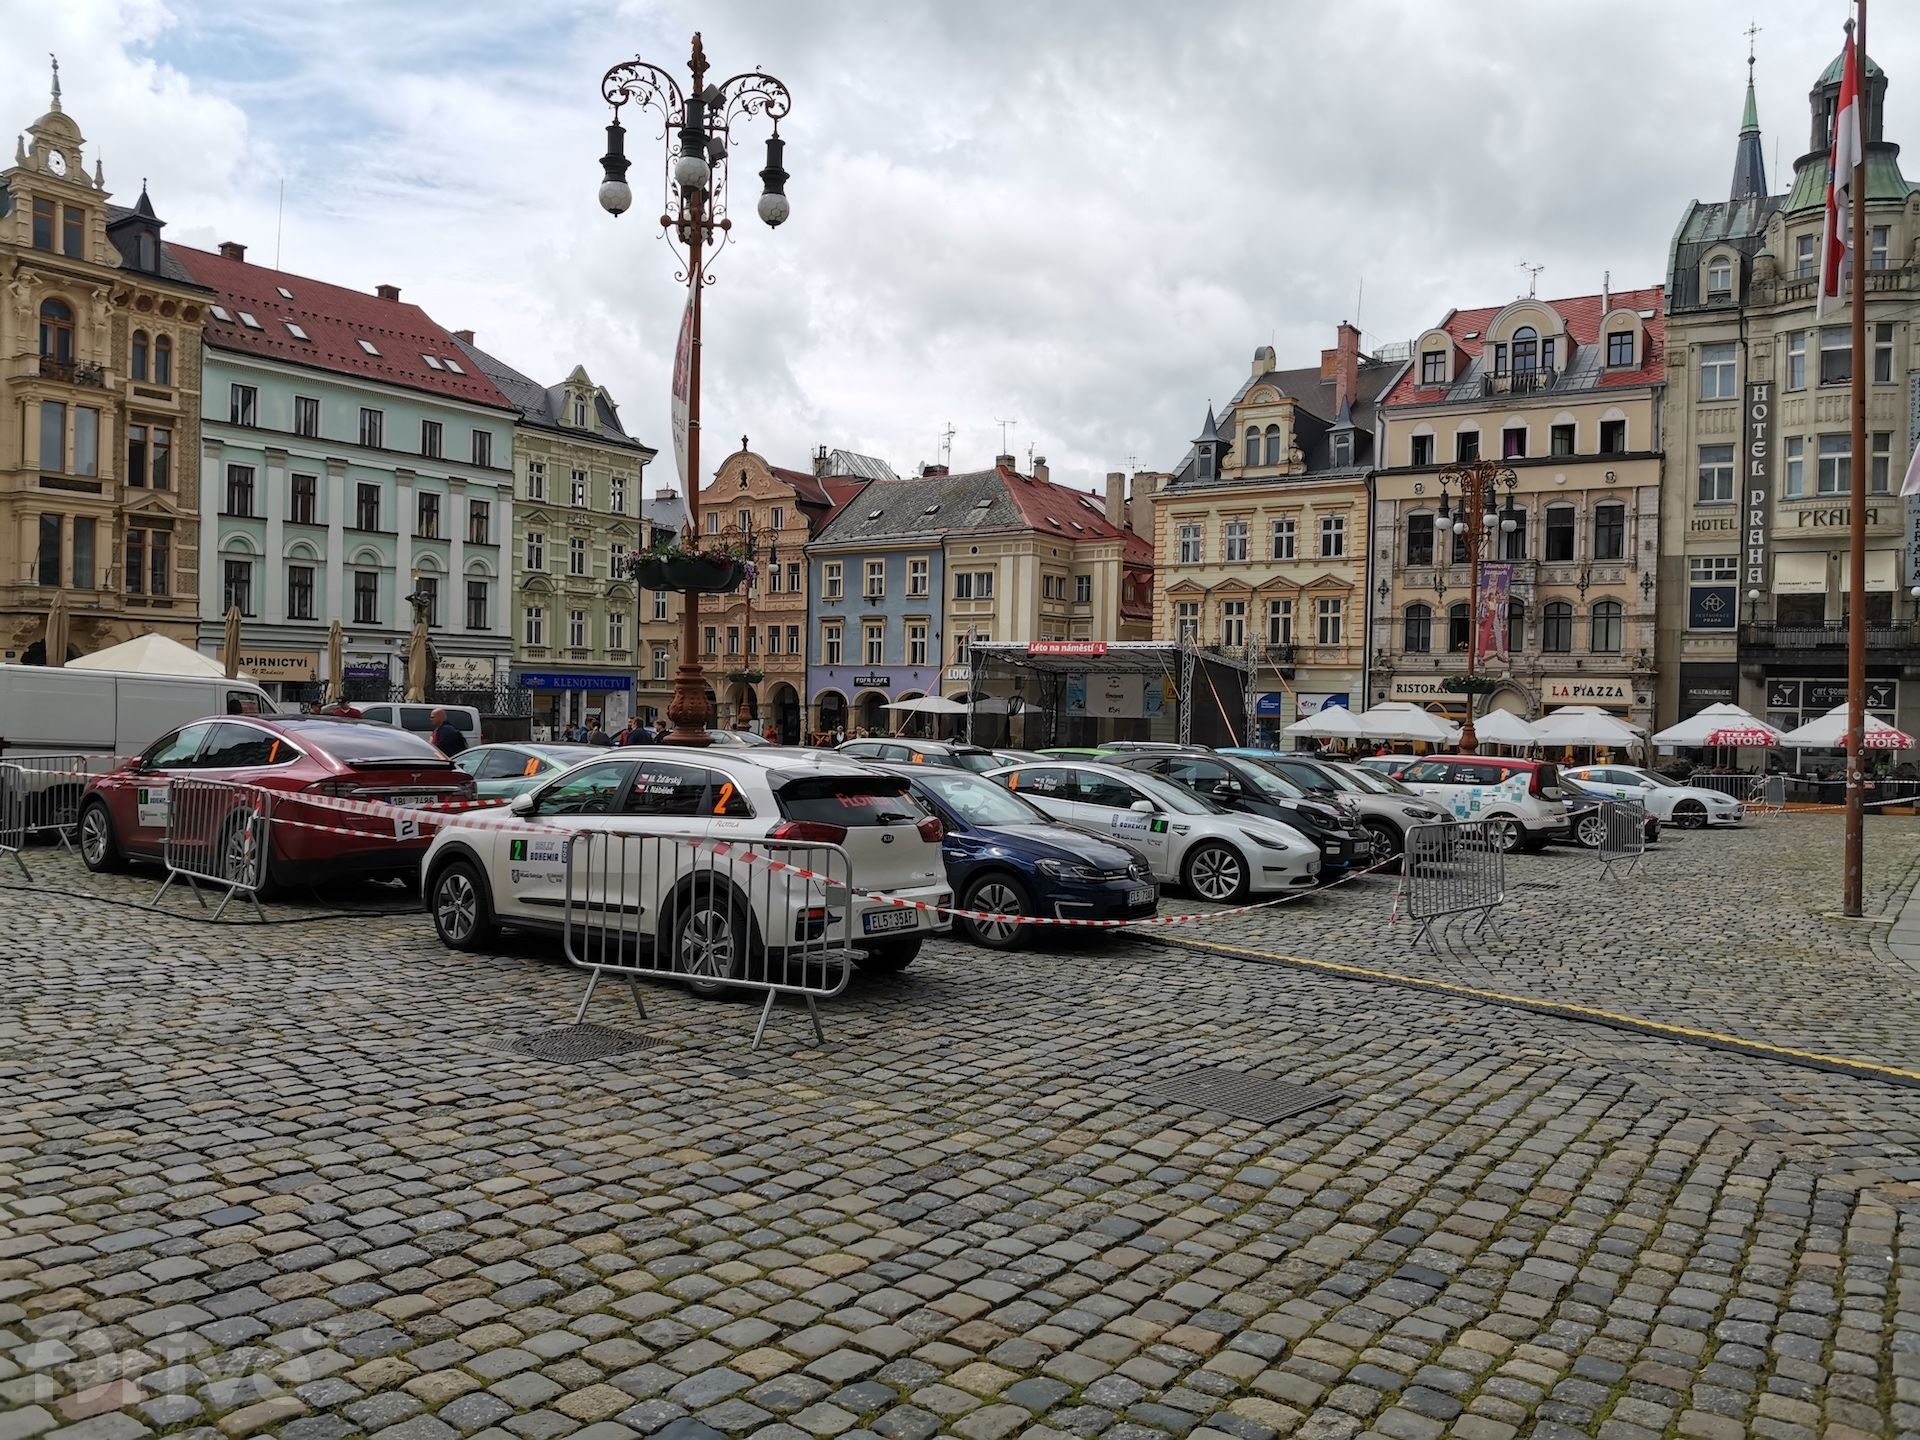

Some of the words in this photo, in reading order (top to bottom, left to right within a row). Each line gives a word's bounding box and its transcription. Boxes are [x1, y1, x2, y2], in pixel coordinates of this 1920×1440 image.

[1751, 386, 1768, 476] HOTEL
[1798, 508, 1880, 528] PRAA
[1691, 519, 1738, 532] HOTEL
[1747, 490, 1765, 584] PRAHA
[1030, 643, 1048, 652] Léto
[1061, 643, 1094, 652] náměstí
[239, 656, 308, 668] APÍRNICTVÍ
[553, 677, 625, 688] KLENOTNICTVÍ
[1552, 686, 1569, 696] LA
[1573, 684, 1624, 697] PIAZZA
[1688, 688, 1732, 696] RESTAURACE
[1717, 737, 1765, 746] ARTOIS
[268, 740, 280, 763] 1
[1008, 772, 1020, 790] 4
[714, 782, 734, 815] 2
[1154, 820, 1162, 832] 4
[514, 840, 522, 860] 2
